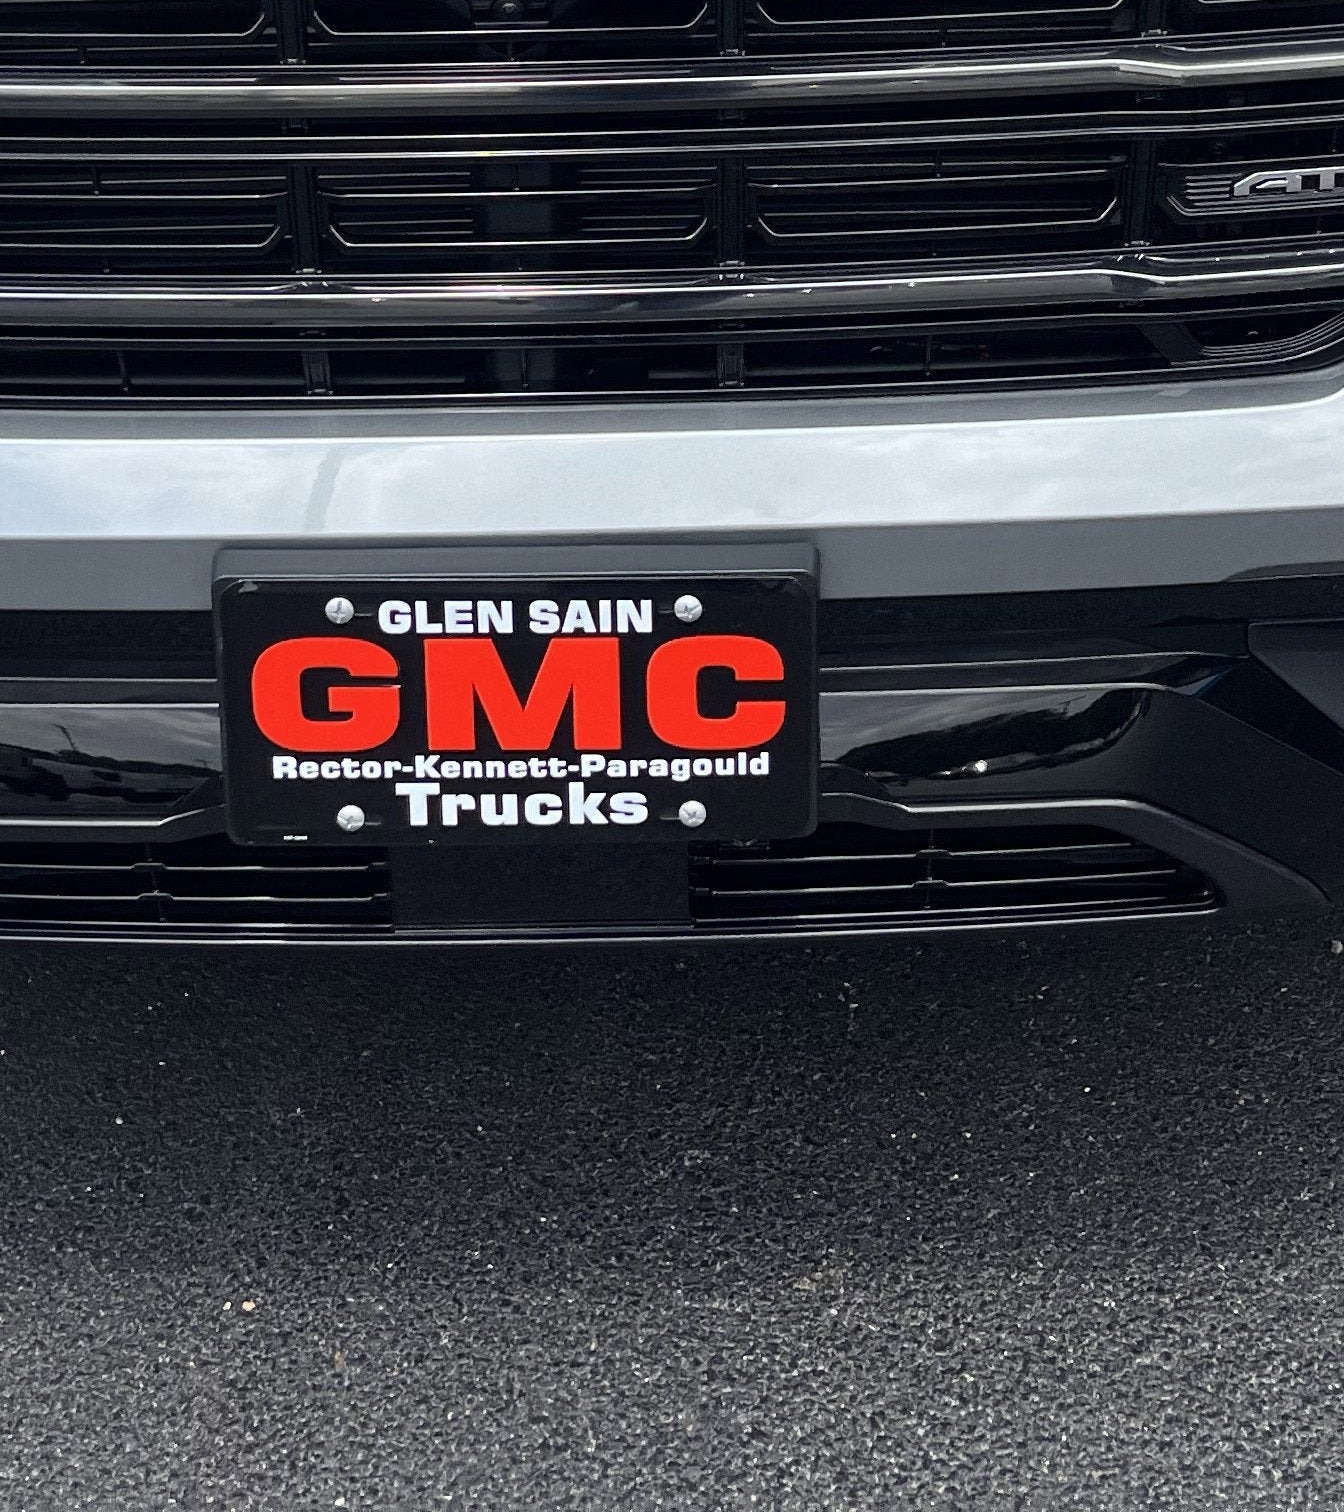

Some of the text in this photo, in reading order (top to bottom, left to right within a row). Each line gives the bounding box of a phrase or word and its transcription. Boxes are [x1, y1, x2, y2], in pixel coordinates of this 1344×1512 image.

[377, 599, 653, 635] GLEN SAIN
[251, 634, 786, 753] GMC
[272, 751, 770, 782] Rector-Kennett-Paragould
[395, 781, 649, 827] Trucks
